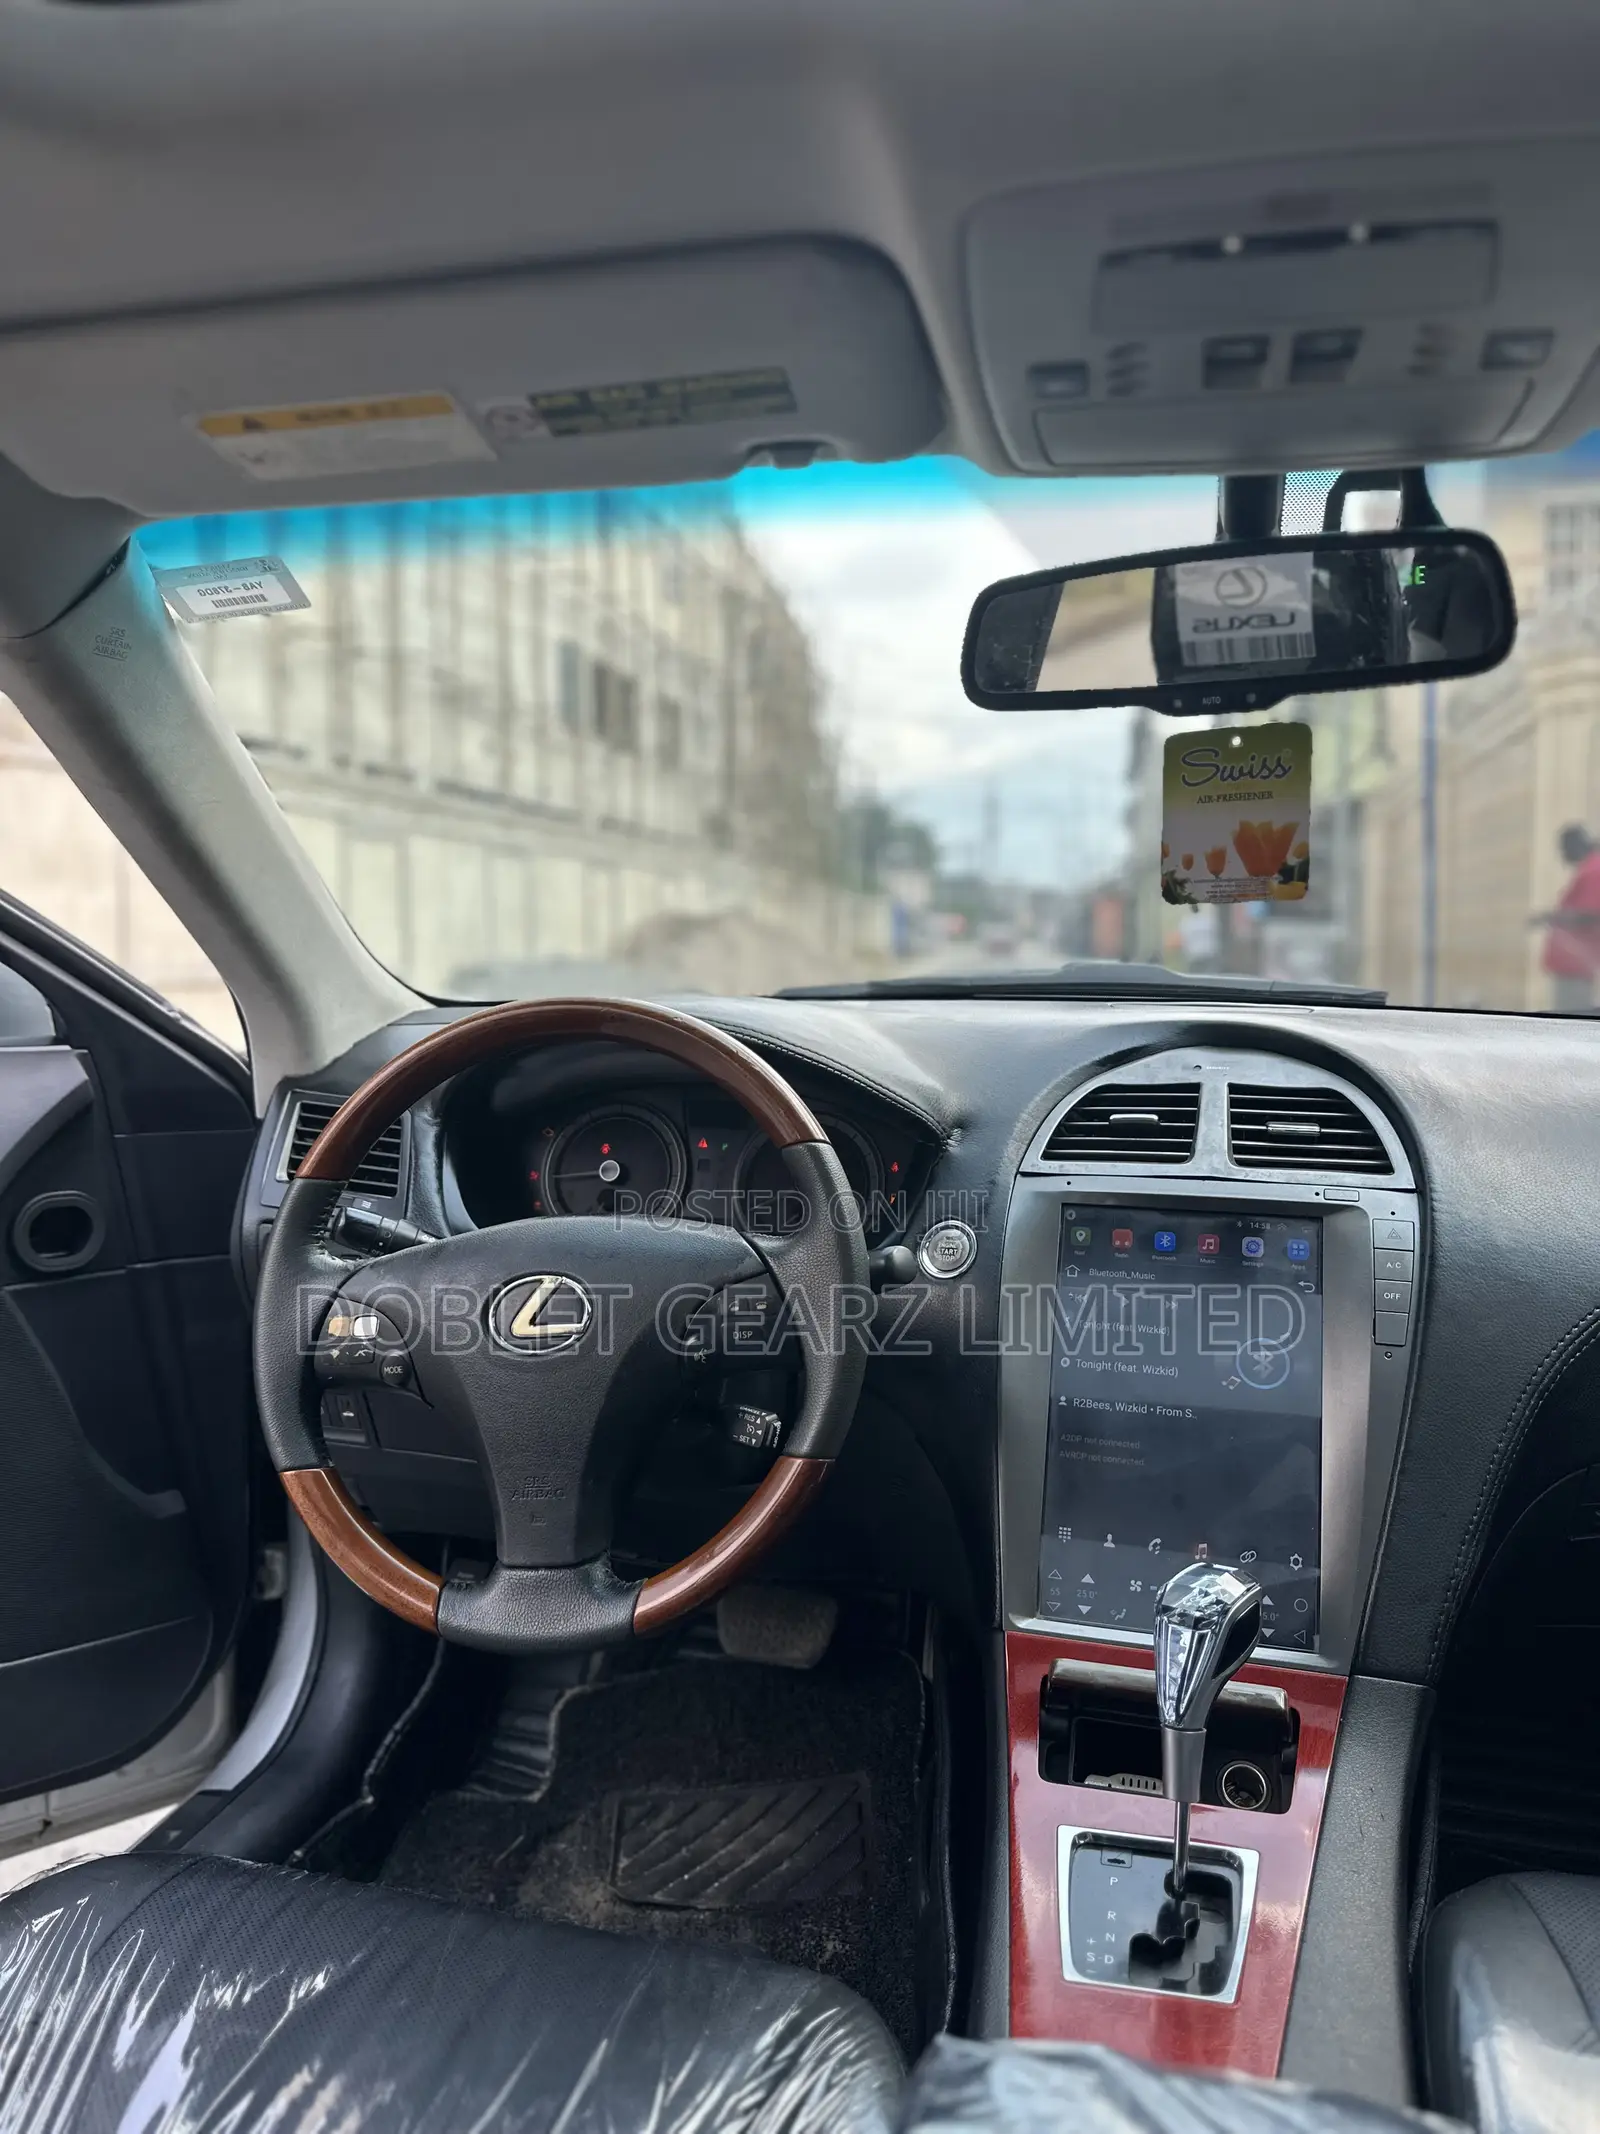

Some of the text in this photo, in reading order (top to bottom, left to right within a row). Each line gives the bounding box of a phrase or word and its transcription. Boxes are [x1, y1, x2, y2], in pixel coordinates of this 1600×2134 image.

[1202, 696, 1221, 704] AUTO
[1182, 748, 1292, 787] Swiss
[1197, 791, 1274, 804] AIR-FRESHENER
[1250, 1222, 1271, 1230] 14:58
[1241, 1260, 1264, 1268] Settings
[1088, 1268, 1156, 1280] Bluetooth_Music
[1383, 1292, 1401, 1300] OFF
[1079, 1319, 1110, 1331] Tonight
[1137, 1324, 1170, 1336] Wizkid)
[732, 1331, 753, 1340] DISP
[383, 1366, 404, 1374] MODE
[1076, 1358, 1179, 1378] Tonight (feat. Wizkid)
[1073, 1398, 1113, 1412] R2Bees,
[1115, 1402, 1148, 1414] Wizkid
[1156, 1406, 1183, 1418] From
[1084, 1436, 1097, 1445] not
[1088, 1453, 1102, 1462] not
[511, 1488, 567, 1500] AIRBAG
[1109, 1877, 1118, 1886] P
[1107, 1910, 1116, 1921] R
[1105, 1932, 1115, 1943] N
[1104, 1954, 1114, 1965] D
